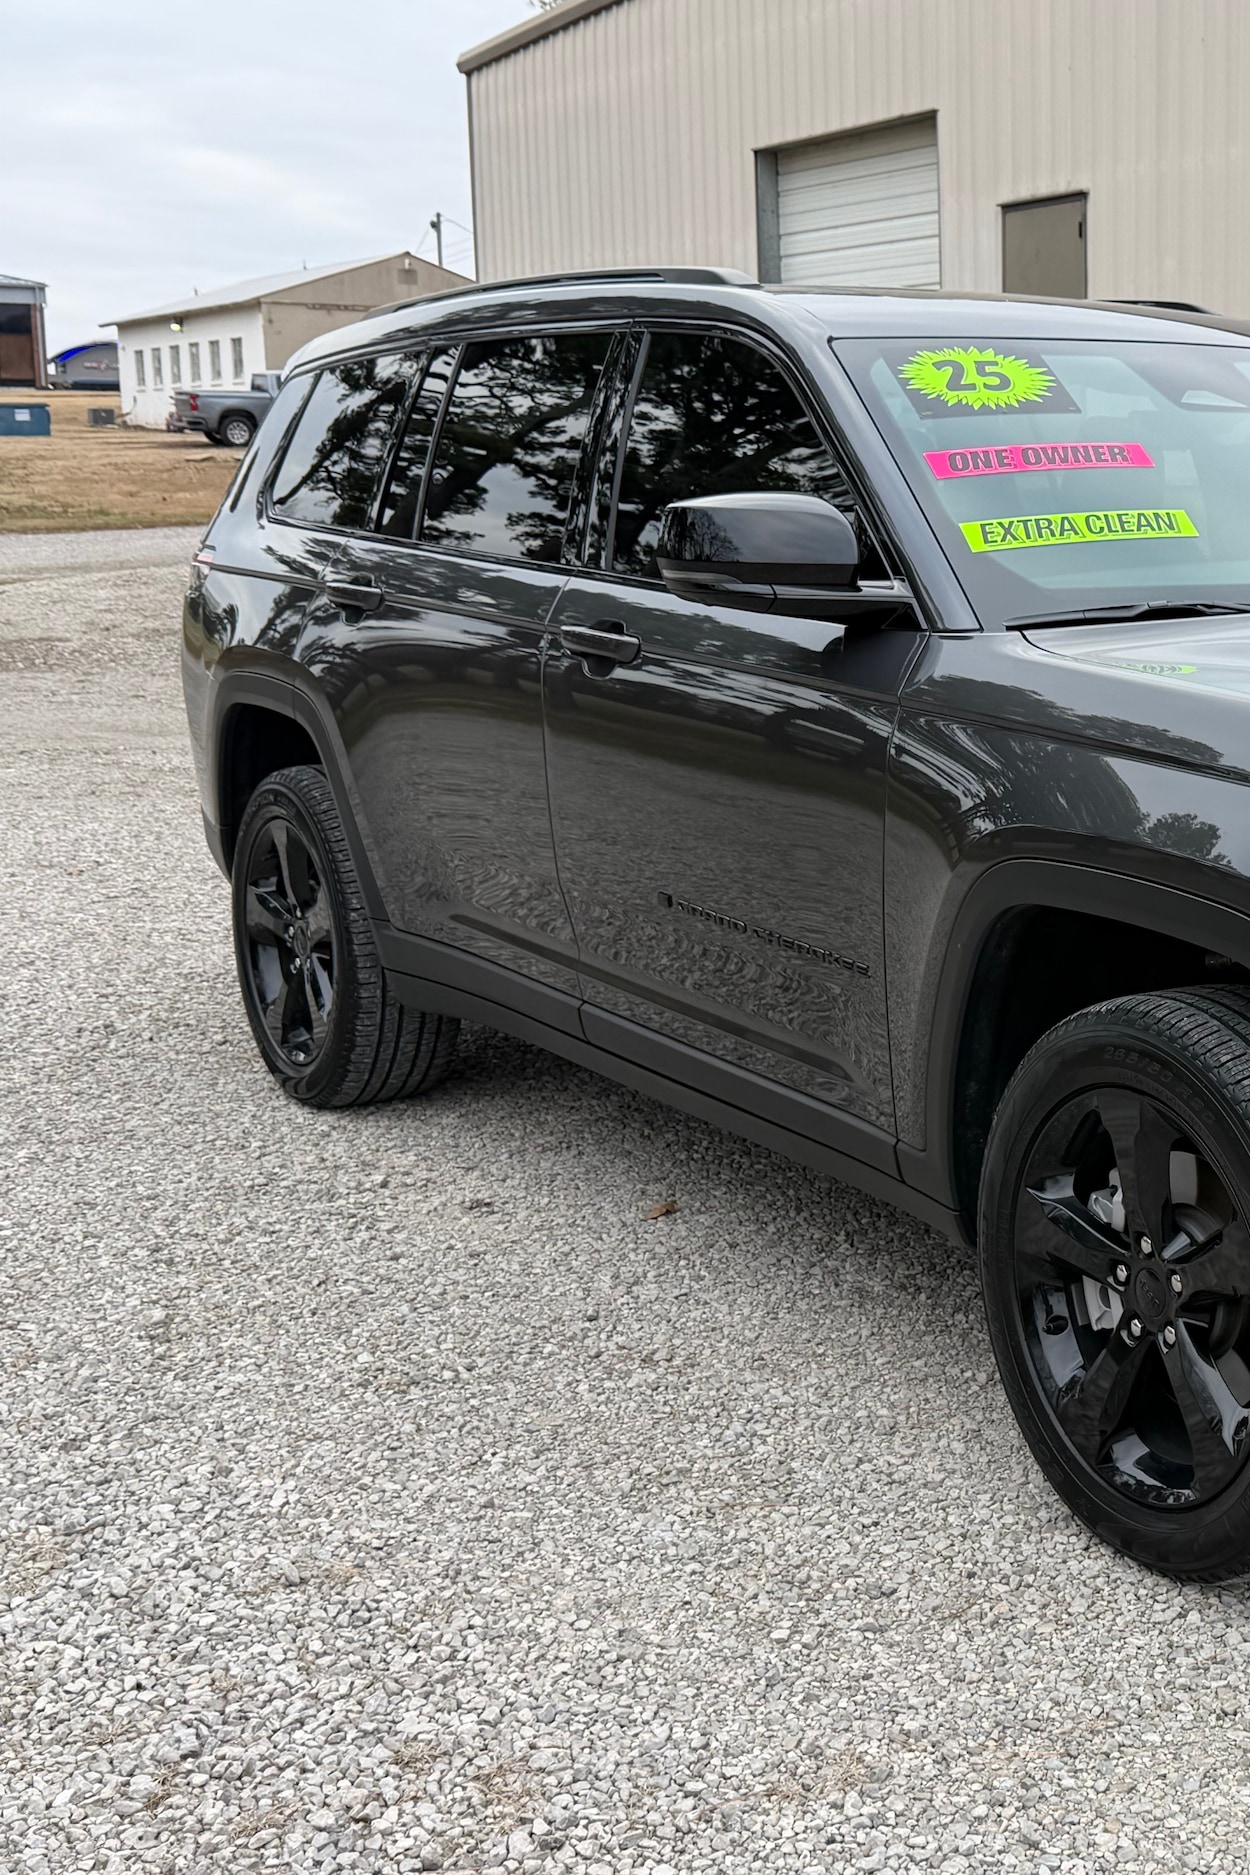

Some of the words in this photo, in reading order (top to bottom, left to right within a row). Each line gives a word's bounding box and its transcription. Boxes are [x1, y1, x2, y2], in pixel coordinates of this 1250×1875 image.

[933, 359, 1013, 393] 25
[947, 449, 1015, 473] ONE
[1020, 445, 1132, 467] OWNER
[979, 515, 1083, 546] EXTRA
[1086, 511, 1180, 537] CLEAN
